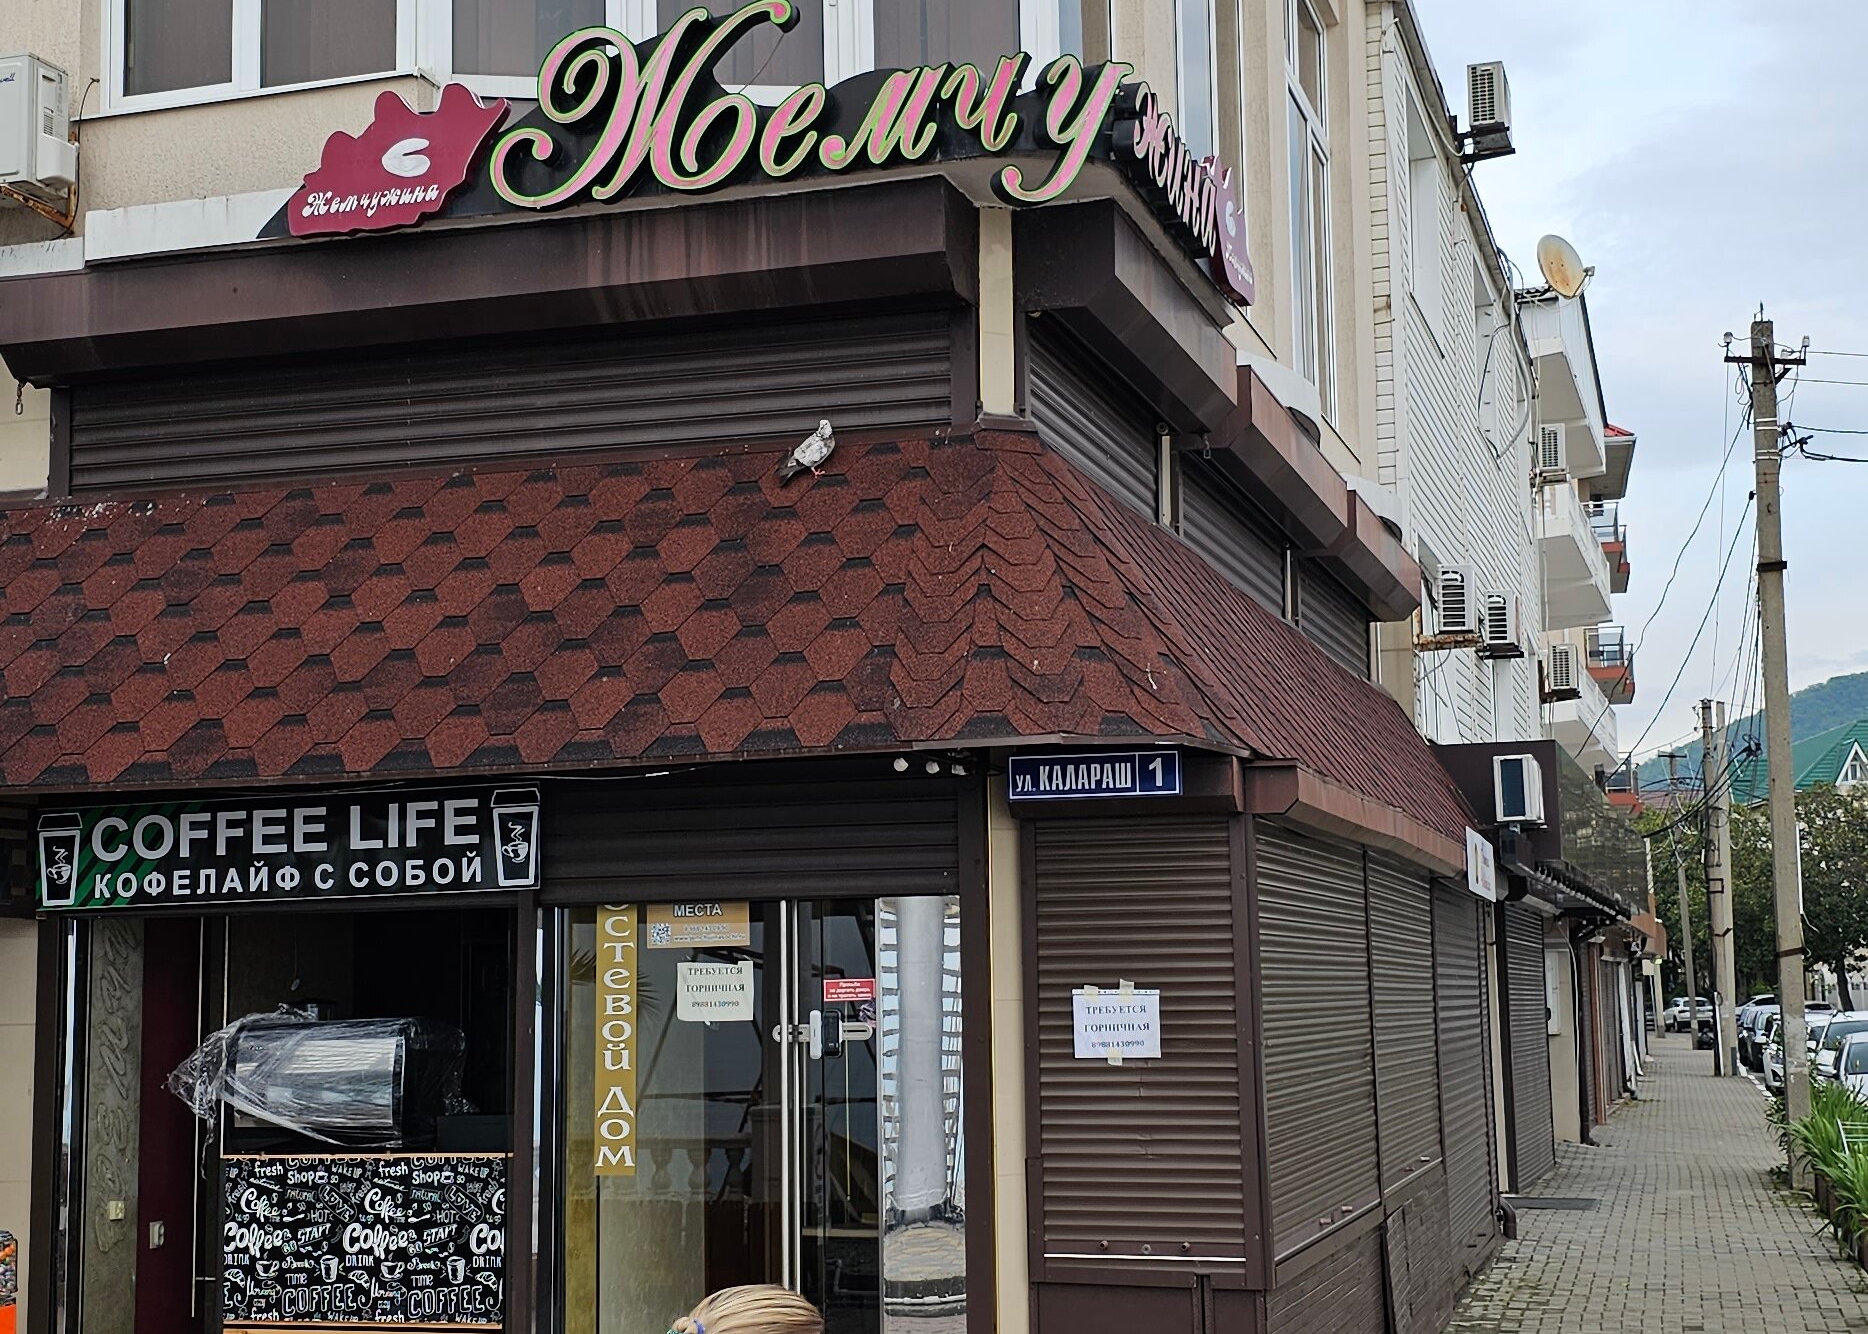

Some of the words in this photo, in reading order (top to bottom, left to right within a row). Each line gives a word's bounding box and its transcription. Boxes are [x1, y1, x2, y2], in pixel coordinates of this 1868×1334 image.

[302, 184, 440, 218] Жемчужина
[1015, 774, 1037, 792] ул.
[1039, 763, 1132, 791] КАЛАРАШ
[1148, 757, 1163, 787] 1
[91, 806, 328, 862] COFFEE
[349, 798, 480, 850] LIFE
[94, 861, 300, 899] КОФЕЛАЙФ
[314, 863, 335, 889] С
[349, 850, 482, 888] СОБОЙ
[673, 903, 723, 918] МЕСТА
[688, 966, 743, 976] ТРЕБУЕТСЯ
[602, 905, 635, 1070] СТЕВОЙ
[686, 984, 745, 993] ГОРНИЧНАЯ
[1085, 1005, 1147, 1015] ТРЕБУЕТСЯ
[1083, 1022, 1150, 1033] ГОРНИЧНАЯ
[254, 1161, 284, 1178] fresh
[378, 1161, 409, 1177] fresh
[287, 1170, 315, 1186] Shop
[411, 1170, 440, 1186] Shop
[240, 1187, 281, 1223] Coffee
[364, 1187, 406, 1224] Coffee
[224, 1222, 283, 1258] Coffee
[343, 1222, 408, 1259] Coffee
[346, 1255, 375, 1267] DRINK
[473, 1256, 502, 1267] DRINK
[285, 1273, 308, 1285] TIME
[411, 1274, 434, 1286] TIME
[282, 1284, 356, 1316] COFFEE
[408, 1285, 485, 1318] COFFEE
